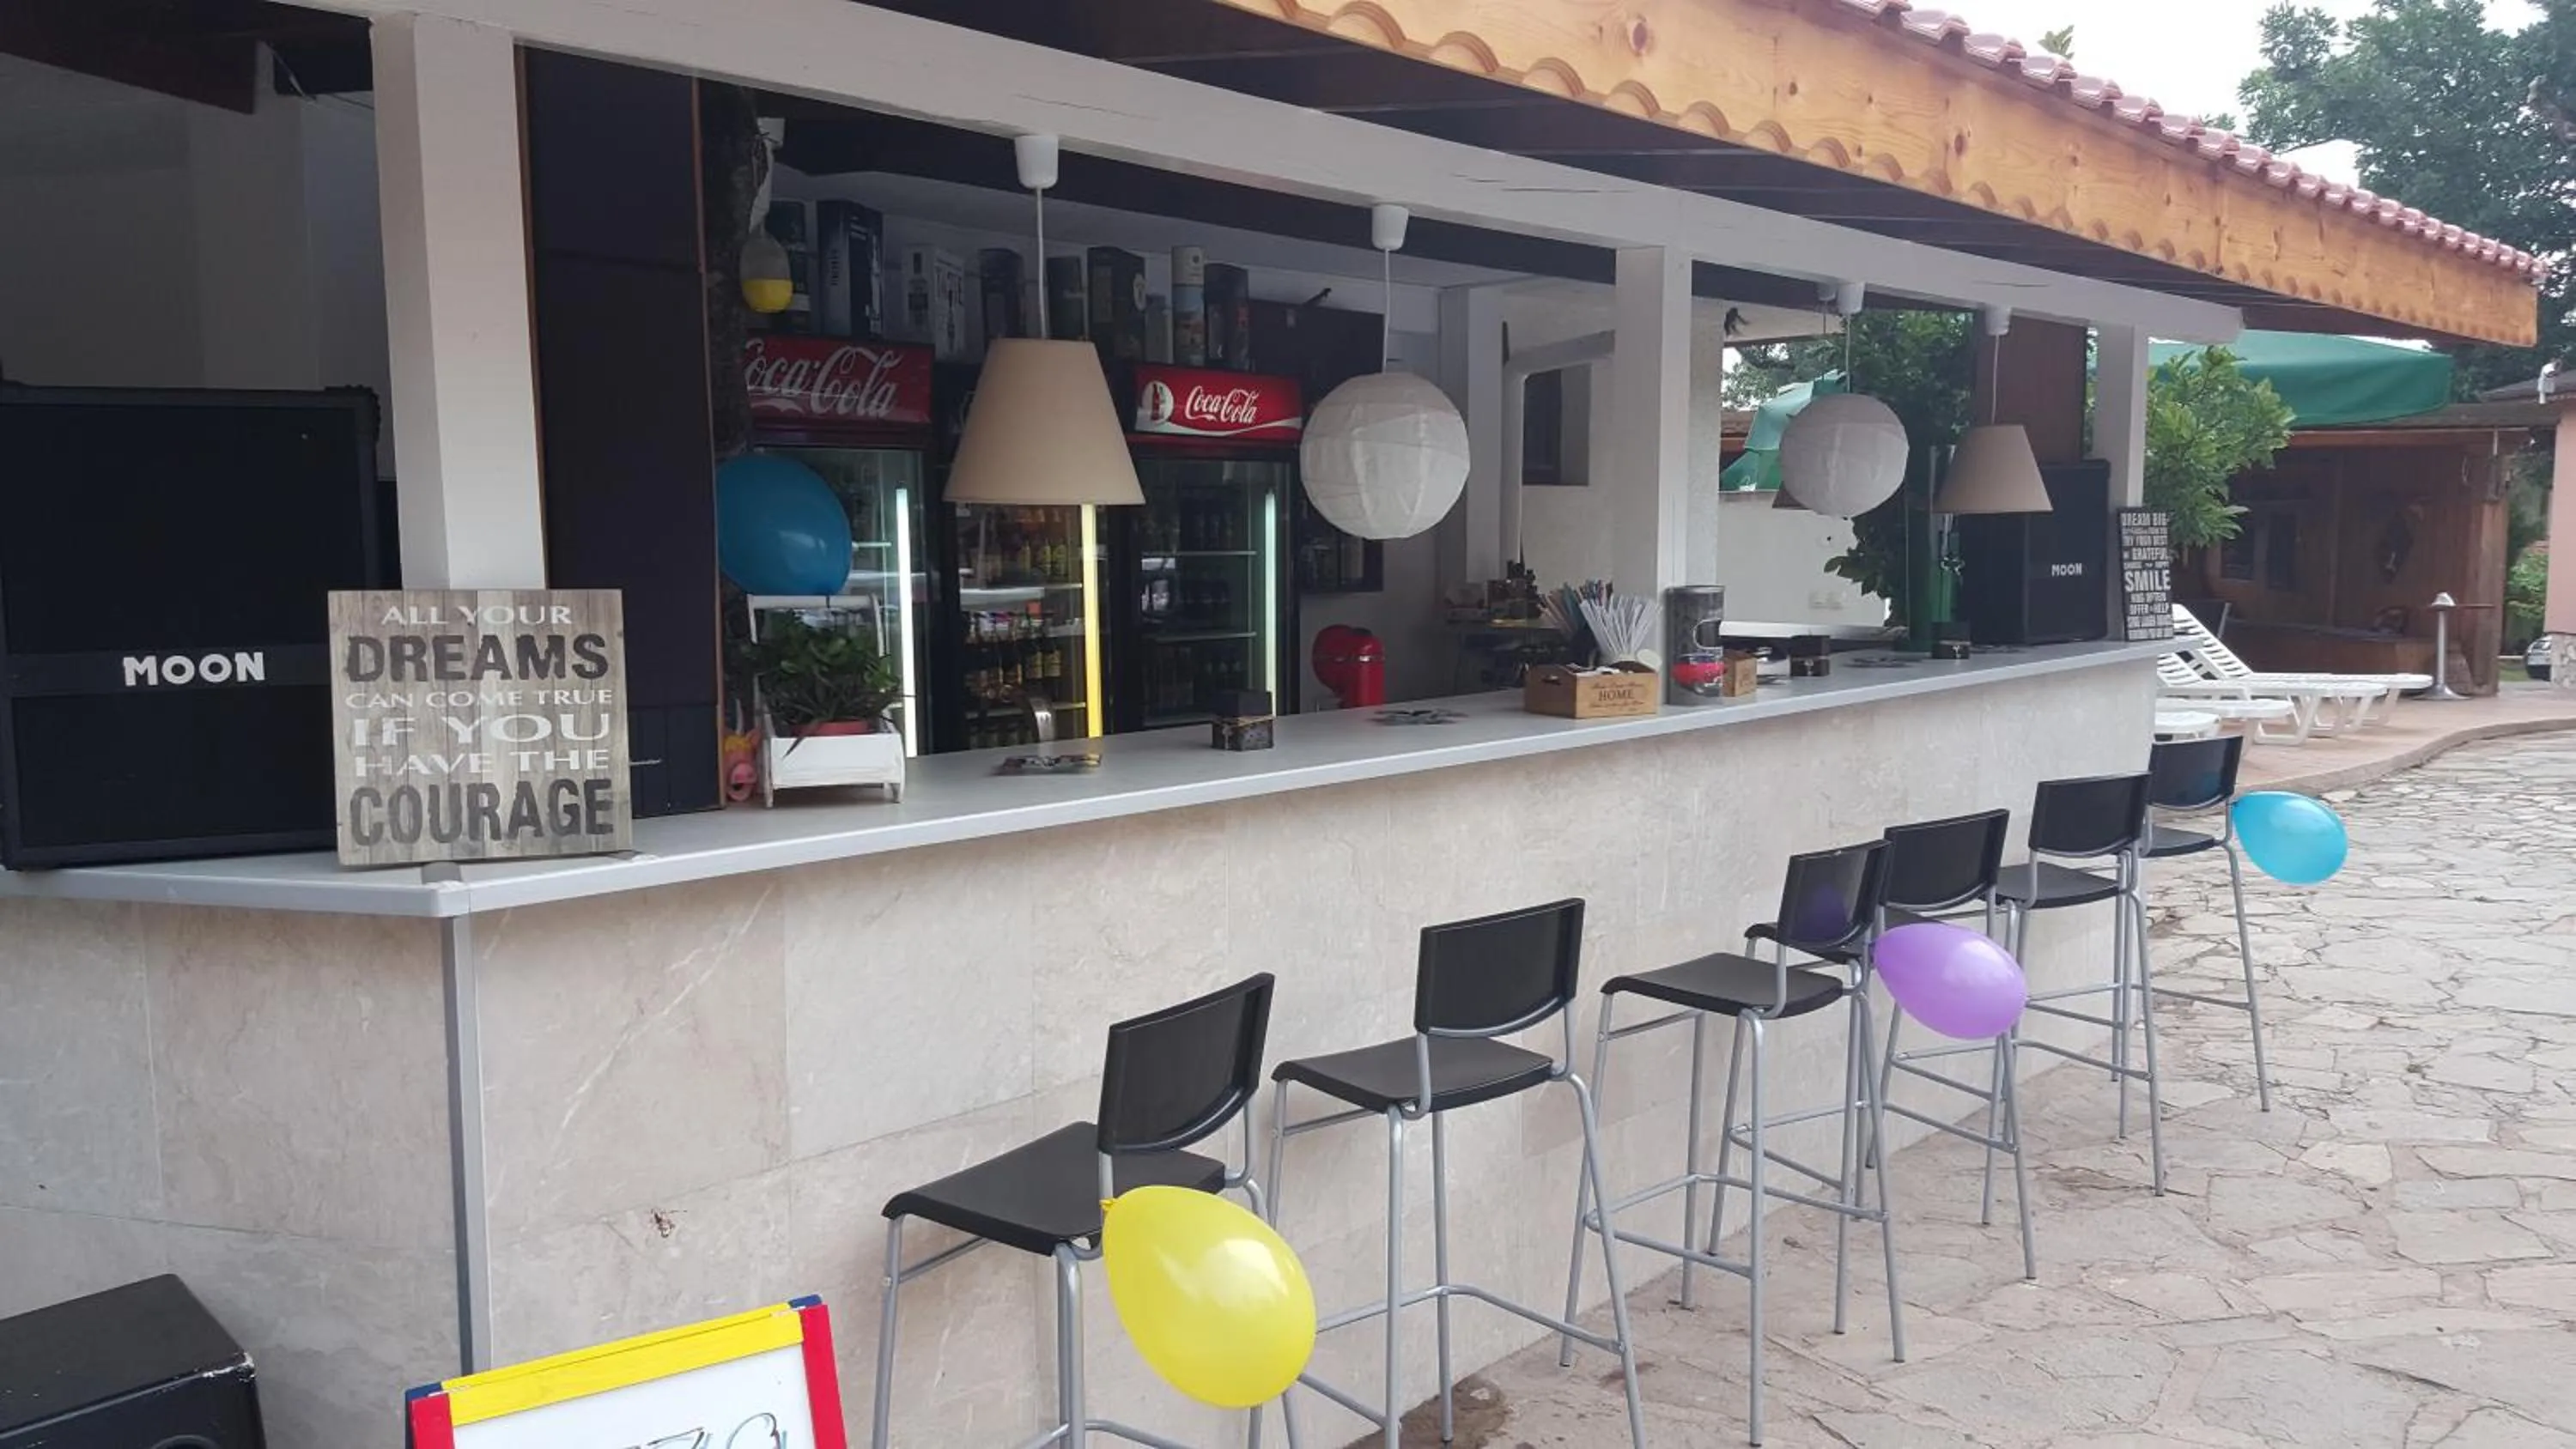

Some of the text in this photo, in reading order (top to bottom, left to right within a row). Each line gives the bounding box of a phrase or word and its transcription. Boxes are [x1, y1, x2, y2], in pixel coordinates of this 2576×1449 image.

[1185, 385, 1260, 423] Coca-Cola
[2051, 562, 2082, 577] MOON
[2124, 569, 2172, 591] SMILE
[381, 605, 573, 626] ALL YOUR
[123, 652, 265, 686] MOON
[345, 633, 609, 682] DREAMS
[345, 688, 612, 709] CAN COME TRUE
[353, 713, 610, 746] IF YOU
[355, 749, 609, 777] HAVE THE
[349, 778, 614, 846] COURAGE
